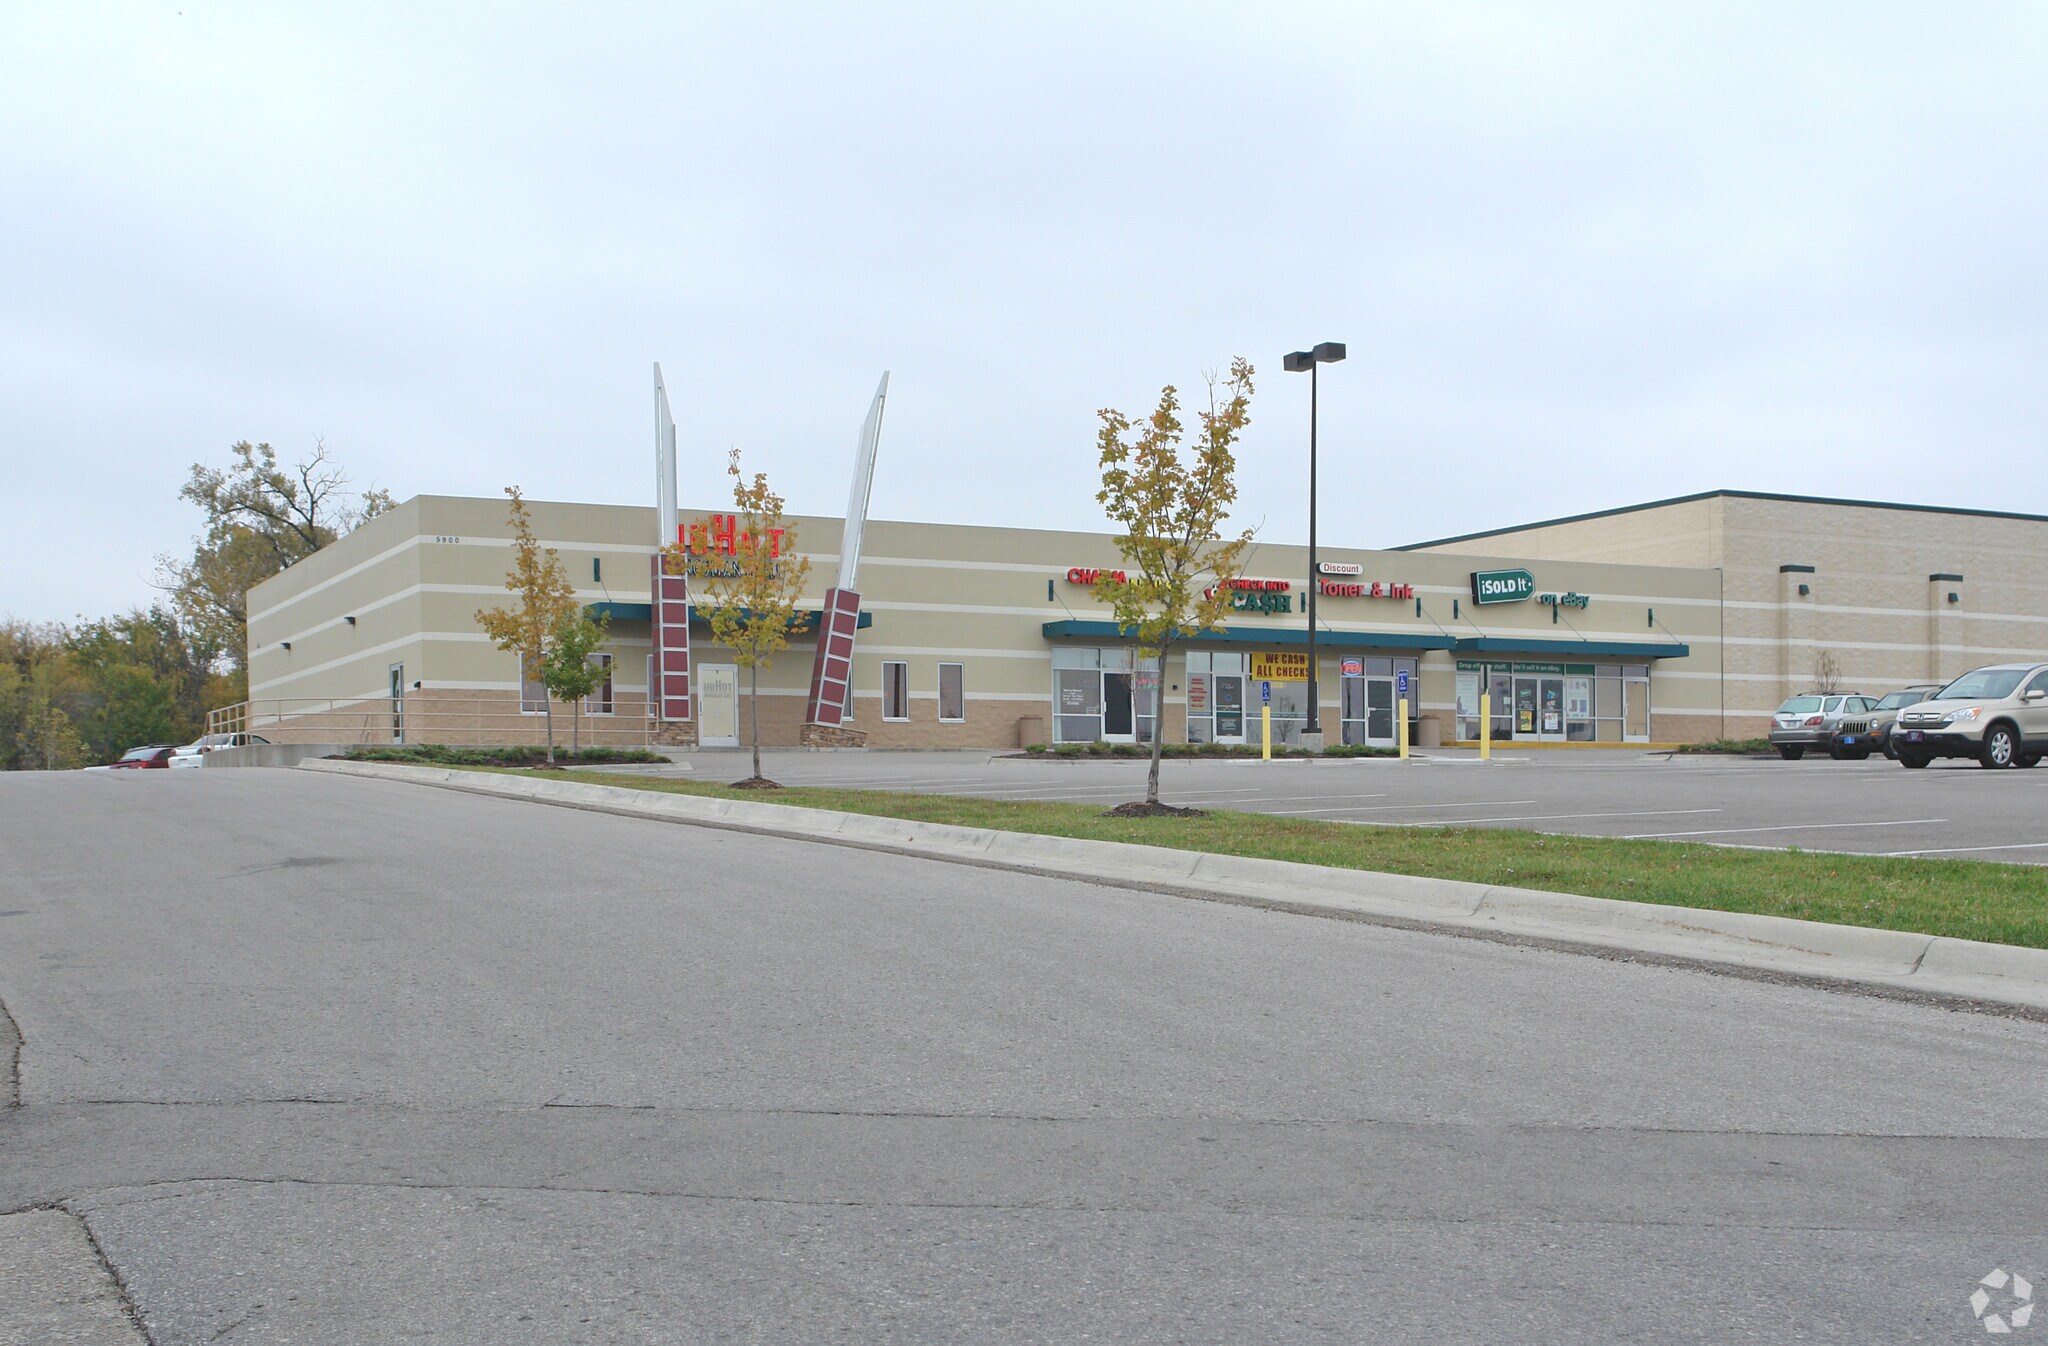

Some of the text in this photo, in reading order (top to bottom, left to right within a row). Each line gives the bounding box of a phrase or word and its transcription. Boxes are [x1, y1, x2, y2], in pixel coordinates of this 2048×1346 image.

[1323, 563, 1360, 573] Discount
[1229, 578, 1290, 591] CHECK INTO
[1318, 578, 1414, 599] Toner & Ink
[1481, 577, 1528, 595] iSOLD It
[1541, 592, 1590, 610] on eBay
[1265, 653, 1306, 665] WE CASH
[1256, 665, 1273, 677] ALL
[1341, 663, 1363, 674] OPEN
